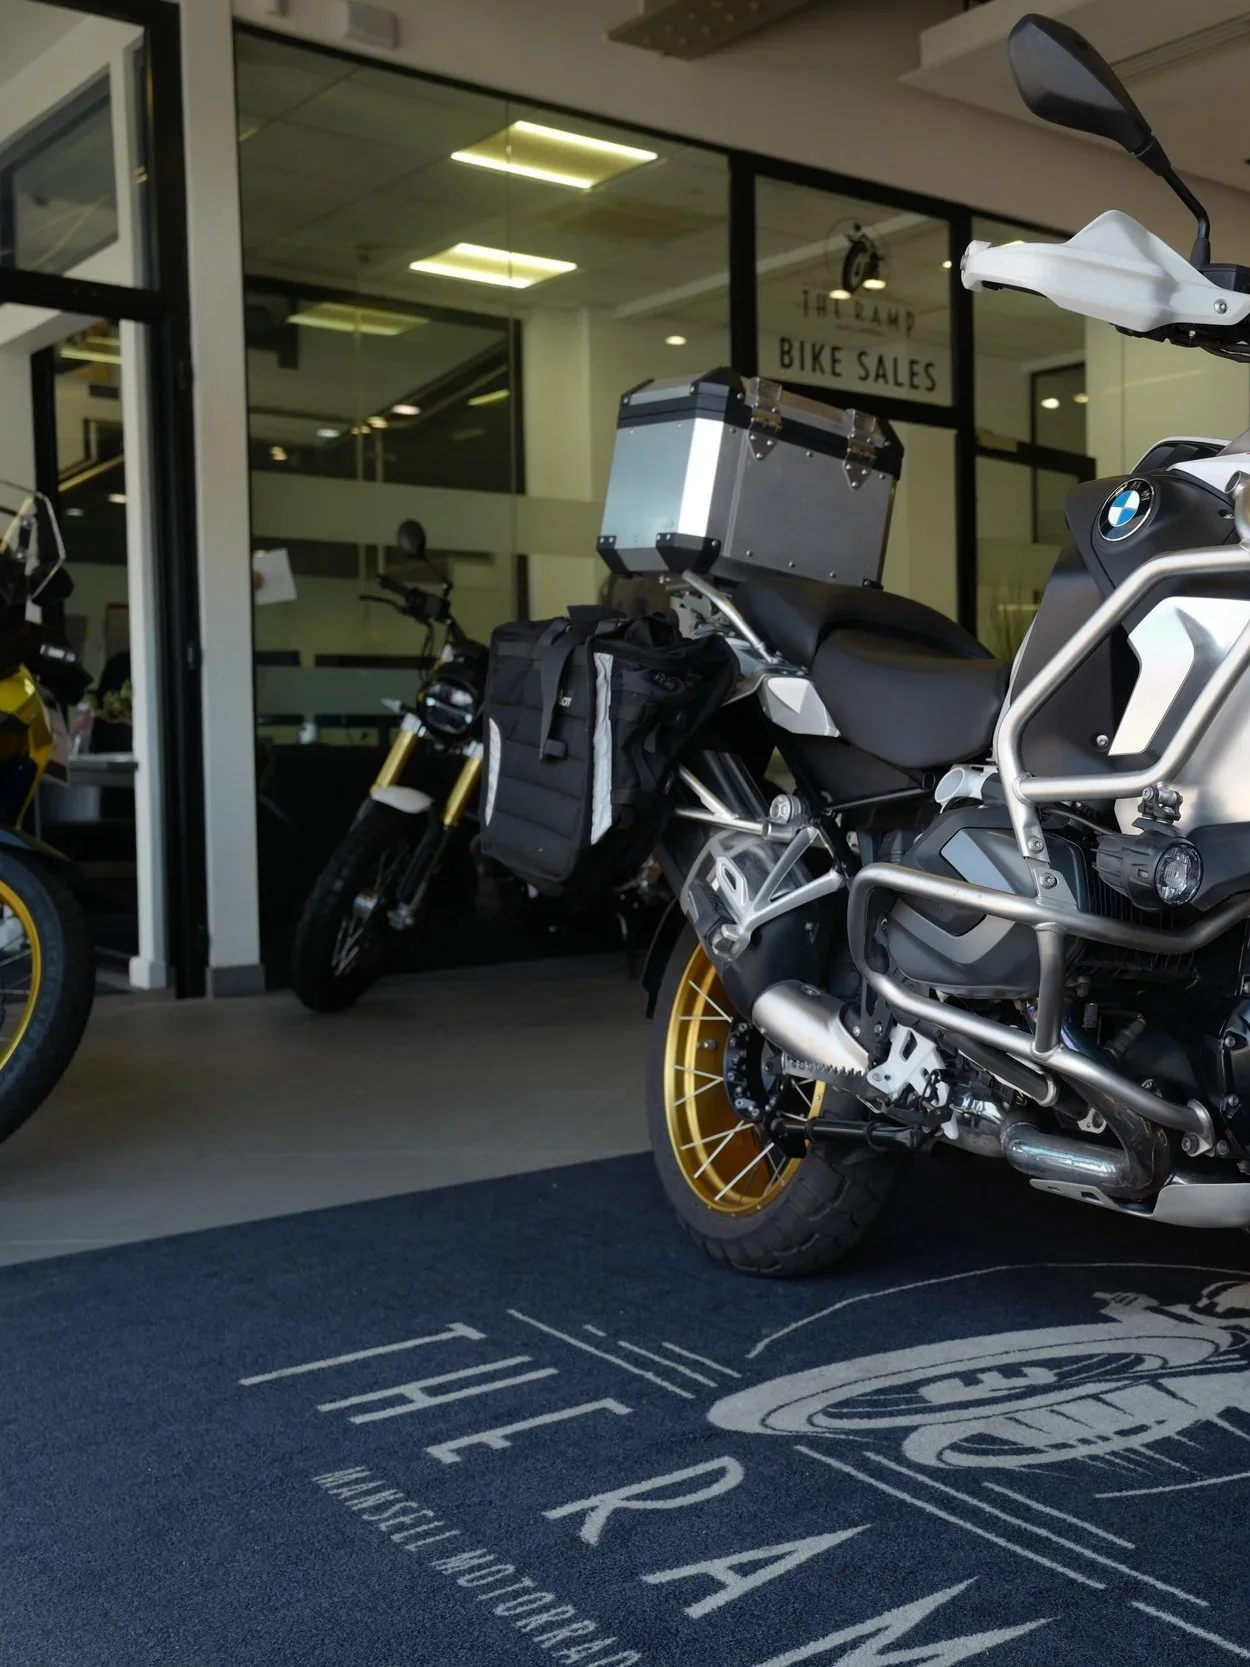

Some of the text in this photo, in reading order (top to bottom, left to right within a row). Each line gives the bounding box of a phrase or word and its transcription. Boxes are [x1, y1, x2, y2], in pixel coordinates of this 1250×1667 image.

[854, 301, 916, 338] RAMP
[779, 337, 937, 393] BIKE SALES
[240, 1322, 634, 1464] THE
[311, 1465, 462, 1551] MANSELL
